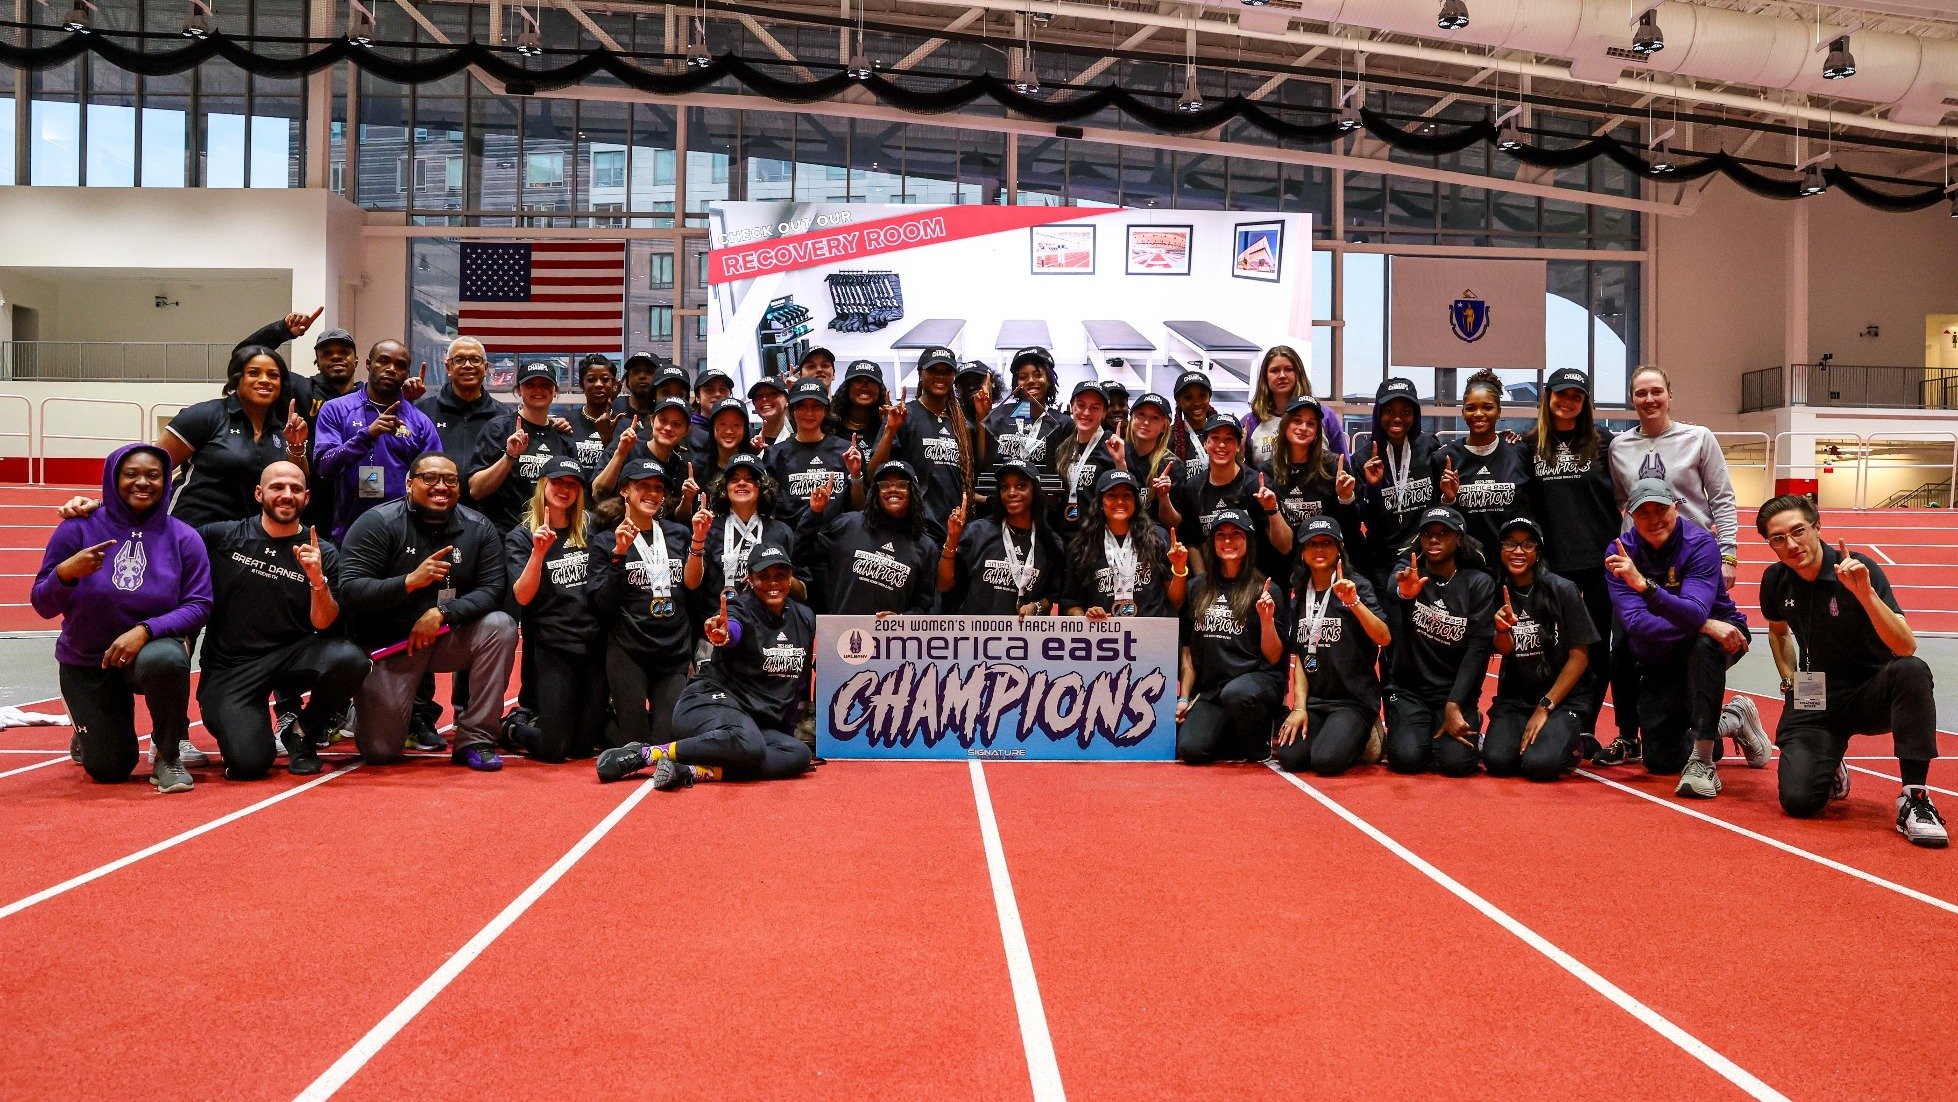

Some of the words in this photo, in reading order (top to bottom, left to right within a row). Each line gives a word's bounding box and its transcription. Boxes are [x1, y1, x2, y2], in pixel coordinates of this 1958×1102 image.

[718, 225, 773, 245] CHECK
[778, 217, 811, 235] OUT
[816, 211, 851, 227] OUR
[722, 232, 859, 276] RECOVERY
[864, 217, 946, 249] ROOM
[528, 363, 548, 371] CHAMPS
[924, 446, 959, 461] CHAMPIO
[1459, 491, 1515, 507] CHAMPIONS
[1218, 511, 1239, 520] CHAMPS
[1428, 508, 1449, 517] CHAMPS
[1309, 520, 1330, 529] CHAMPS
[232, 552, 266, 569] GREAT
[268, 564, 305, 582] DANES
[853, 559, 907, 587] CHAMPIONS
[875, 620, 904, 631] 2024
[911, 620, 965, 632] WOMEN'S
[972, 620, 1013, 632] INDOOR
[1019, 620, 1055, 632] TRACK
[1061, 621, 1083, 632] AND
[1089, 621, 1121, 632] FIELD
[1042, 631, 1137, 661] east
[829, 661, 1166, 749] CHAMPIONS
